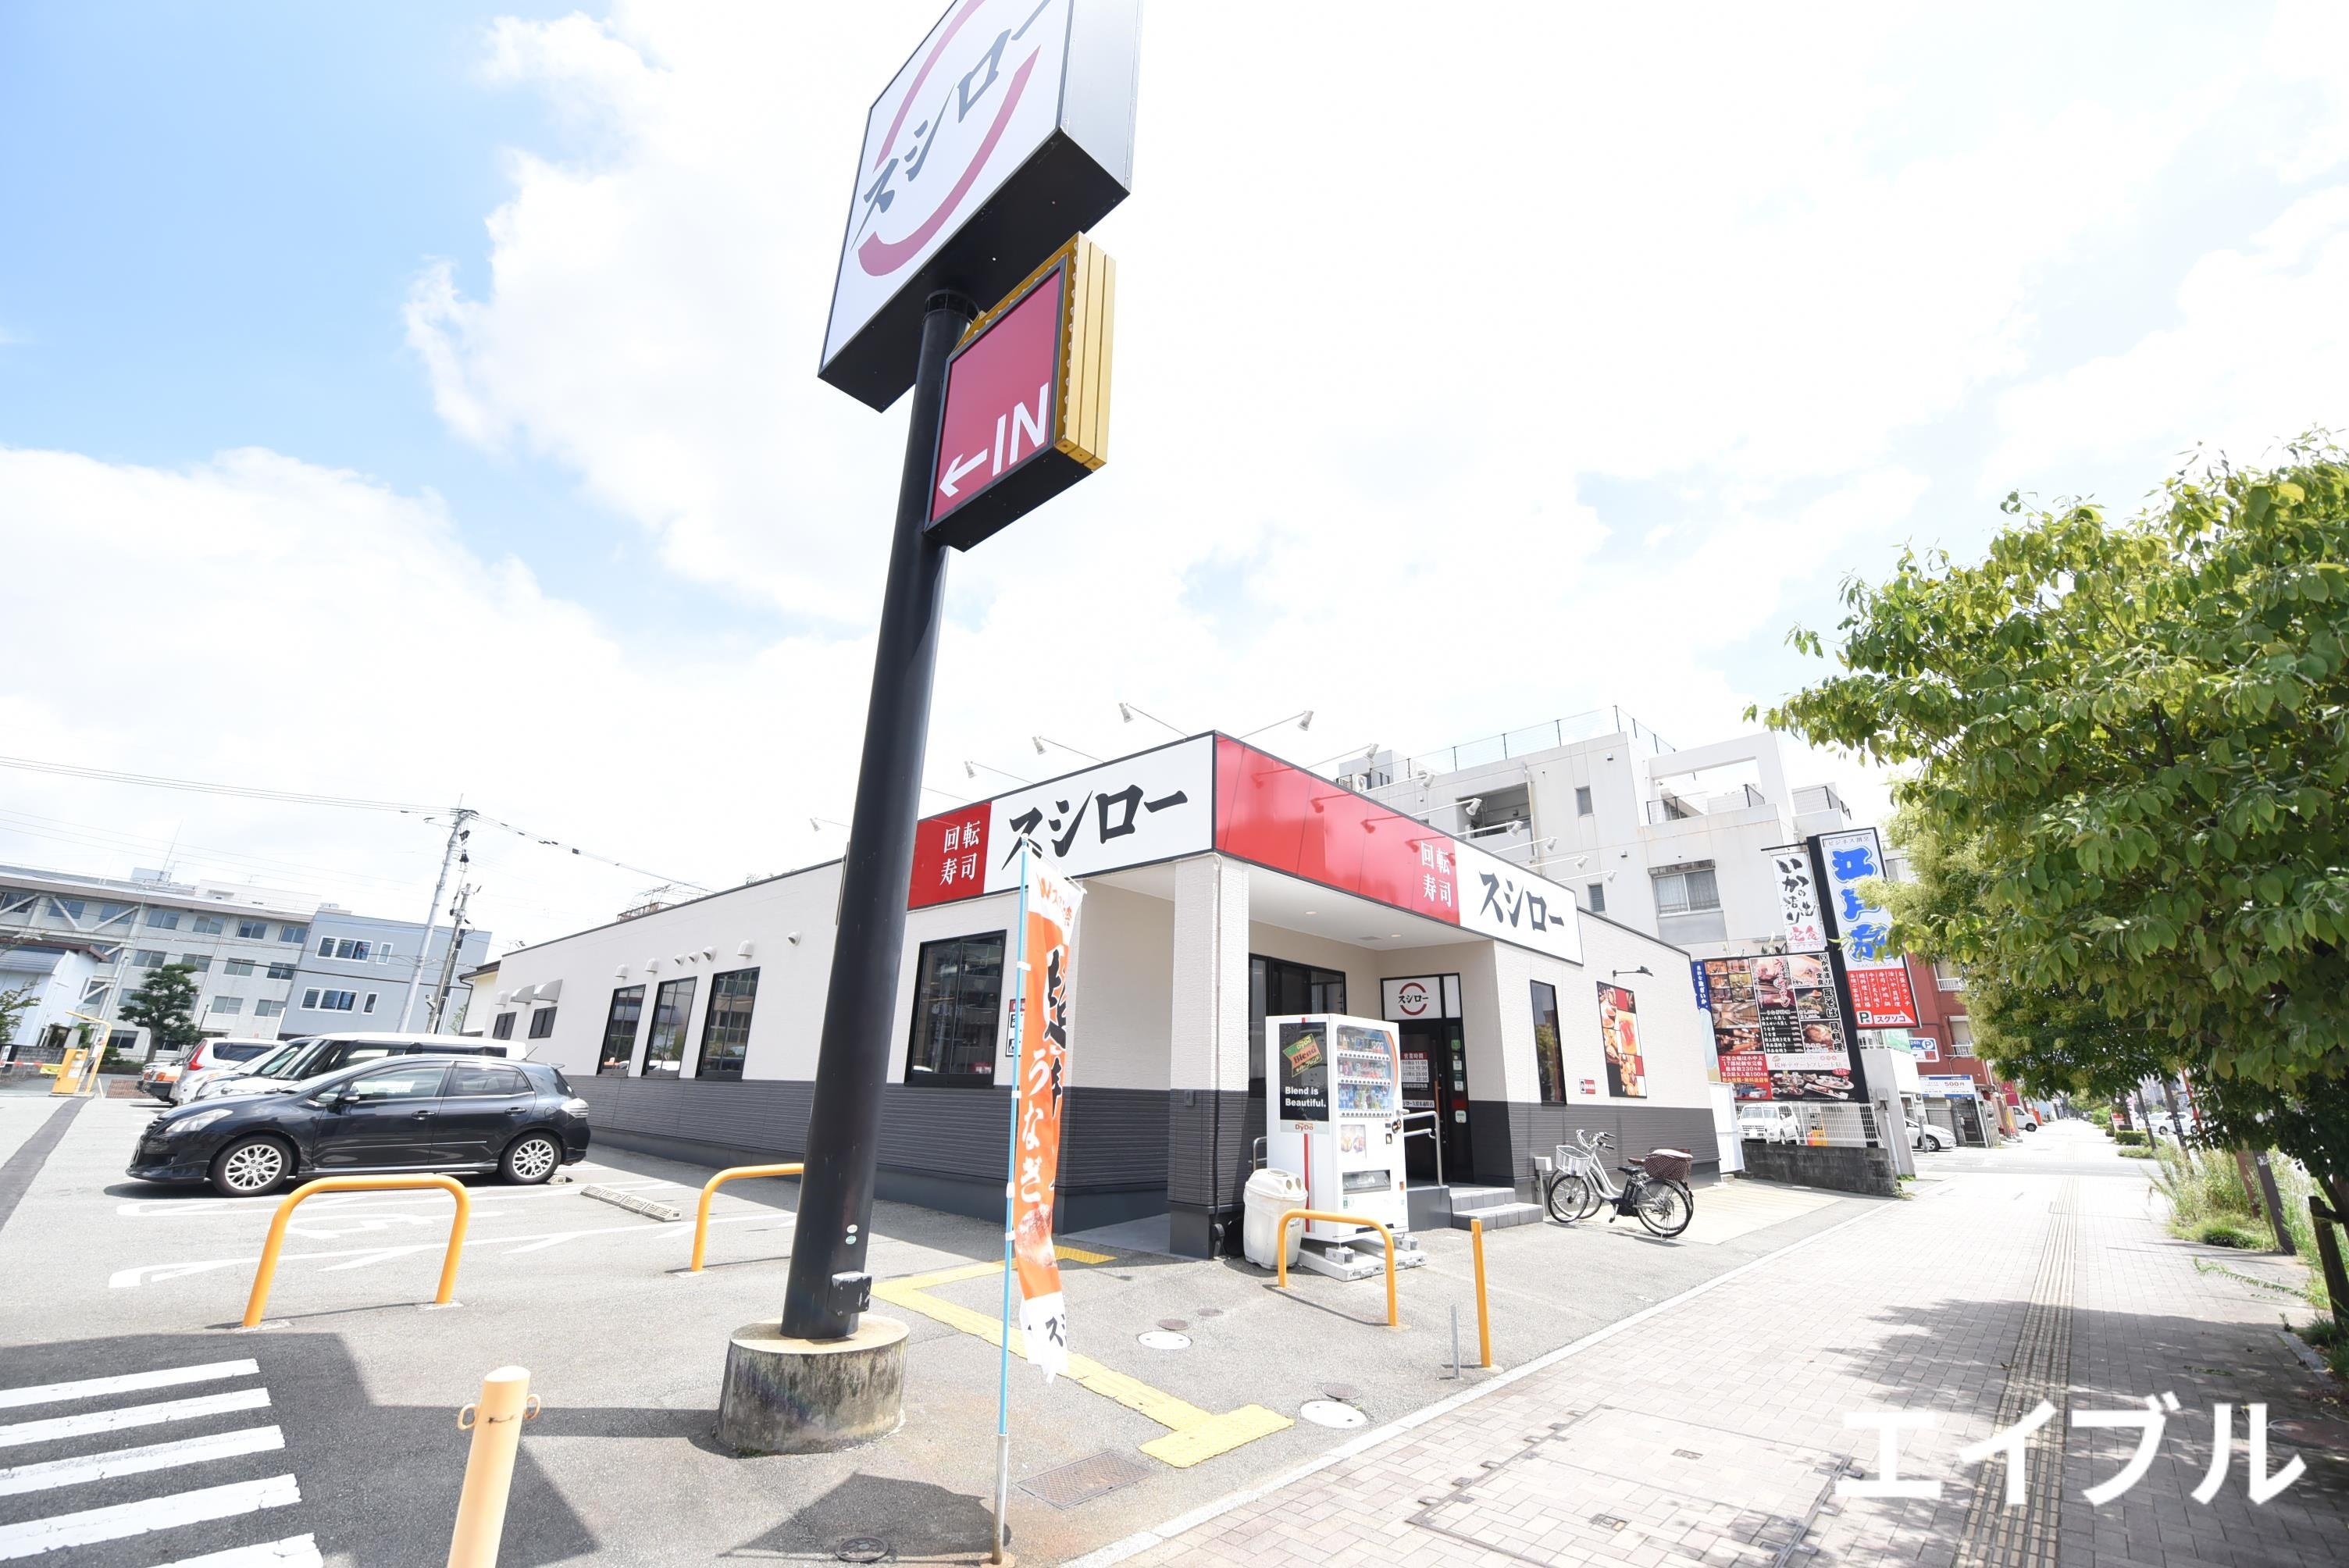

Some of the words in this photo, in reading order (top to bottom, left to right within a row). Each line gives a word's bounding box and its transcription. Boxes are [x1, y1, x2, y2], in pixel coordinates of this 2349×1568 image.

[992, 382, 1049, 476] IN
[943, 820, 981, 853] 回転
[1001, 784, 1188, 871] スシロー
[939, 853, 977, 886] 寿司
[1420, 841, 1451, 876] 回転
[1422, 874, 1453, 908] 寿司
[1478, 869, 1565, 932] スシロー
[1398, 992, 1430, 1005] スシロー
[1822, 987, 1838, 1018] 瓦そば
[1292, 1046, 1317, 1064] Blend
[1285, 1086, 1309, 1095] Blend
[1285, 1098, 1327, 1108] Beautiful.
[1021, 1047, 1050, 1203] うなぎ
[1295, 1123, 1314, 1131] DyDo
